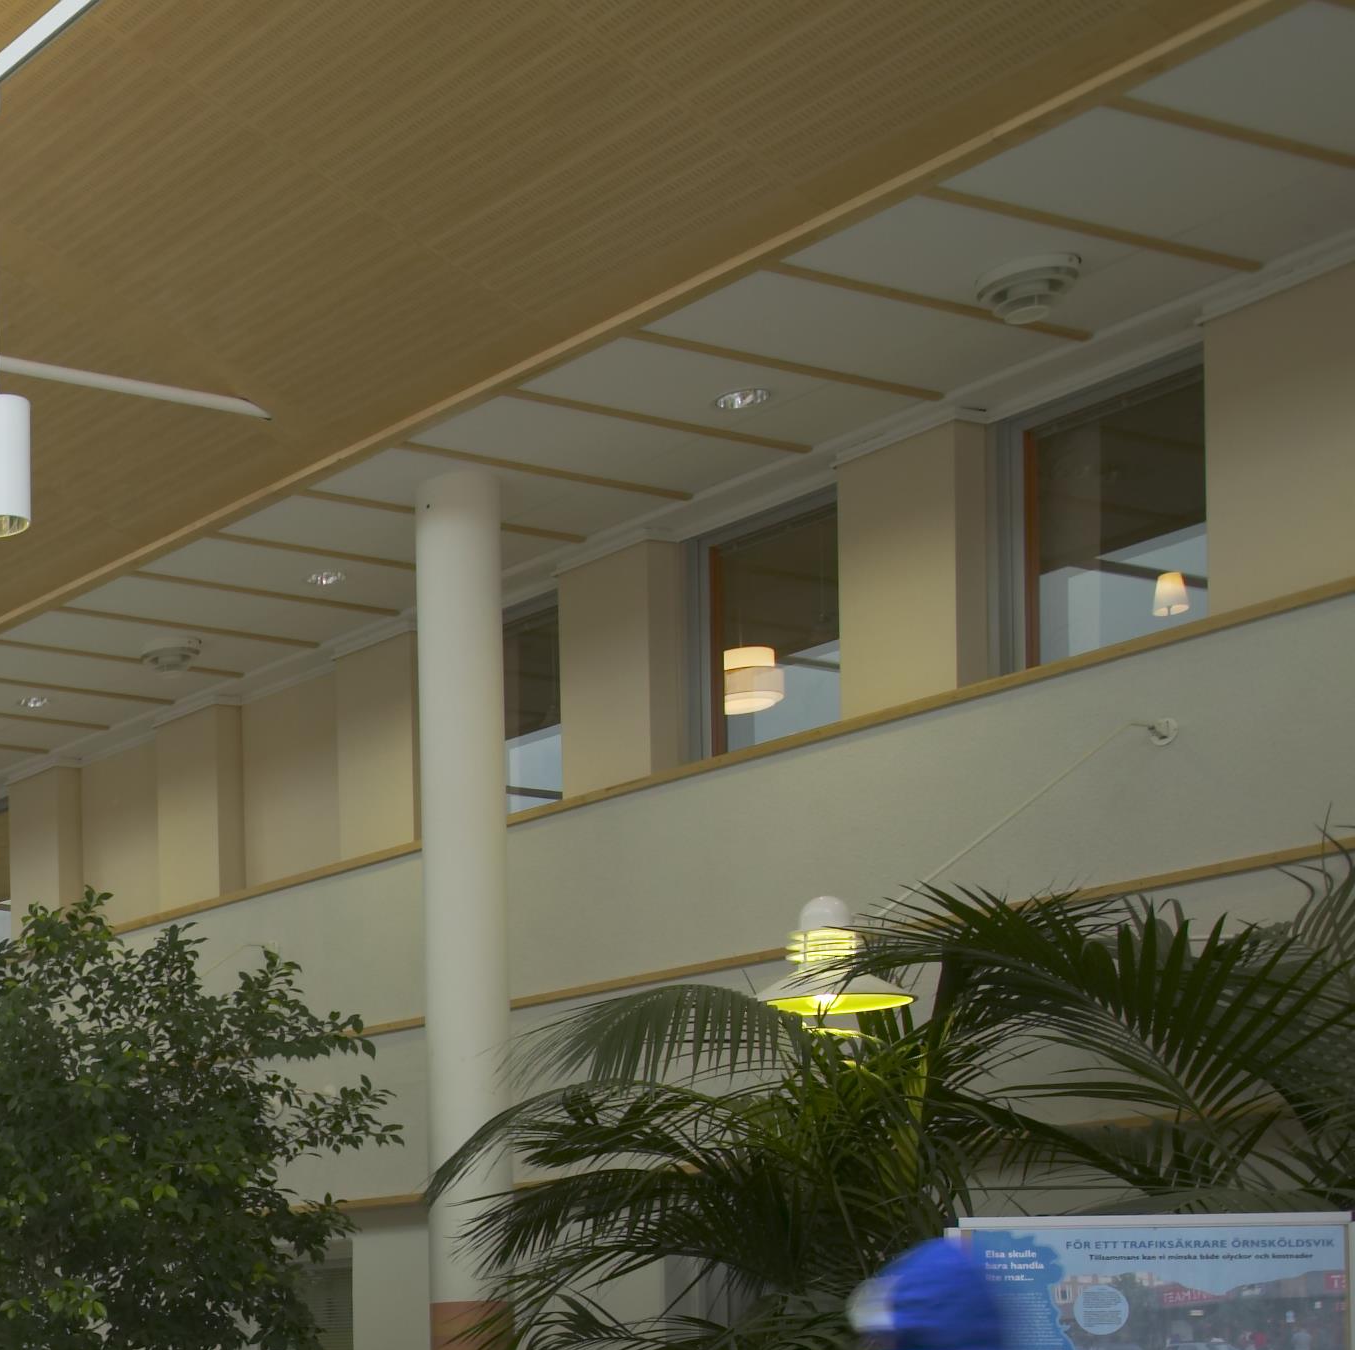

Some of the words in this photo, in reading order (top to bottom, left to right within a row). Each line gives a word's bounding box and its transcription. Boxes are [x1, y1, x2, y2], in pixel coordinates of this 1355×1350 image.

[1066, 1238, 1091, 1250] FÖR
[1095, 1240, 1118, 1249] ETT
[1122, 1237, 1227, 1249] TRAFIKSÄKRARE
[1231, 1236, 1334, 1249] ÖRNSKÖLDSVIK
[1089, 1253, 1140, 1261] Tillsammans
[1272, 1252, 1313, 1260] kostnader
[1010, 1262, 1044, 1270] handla
